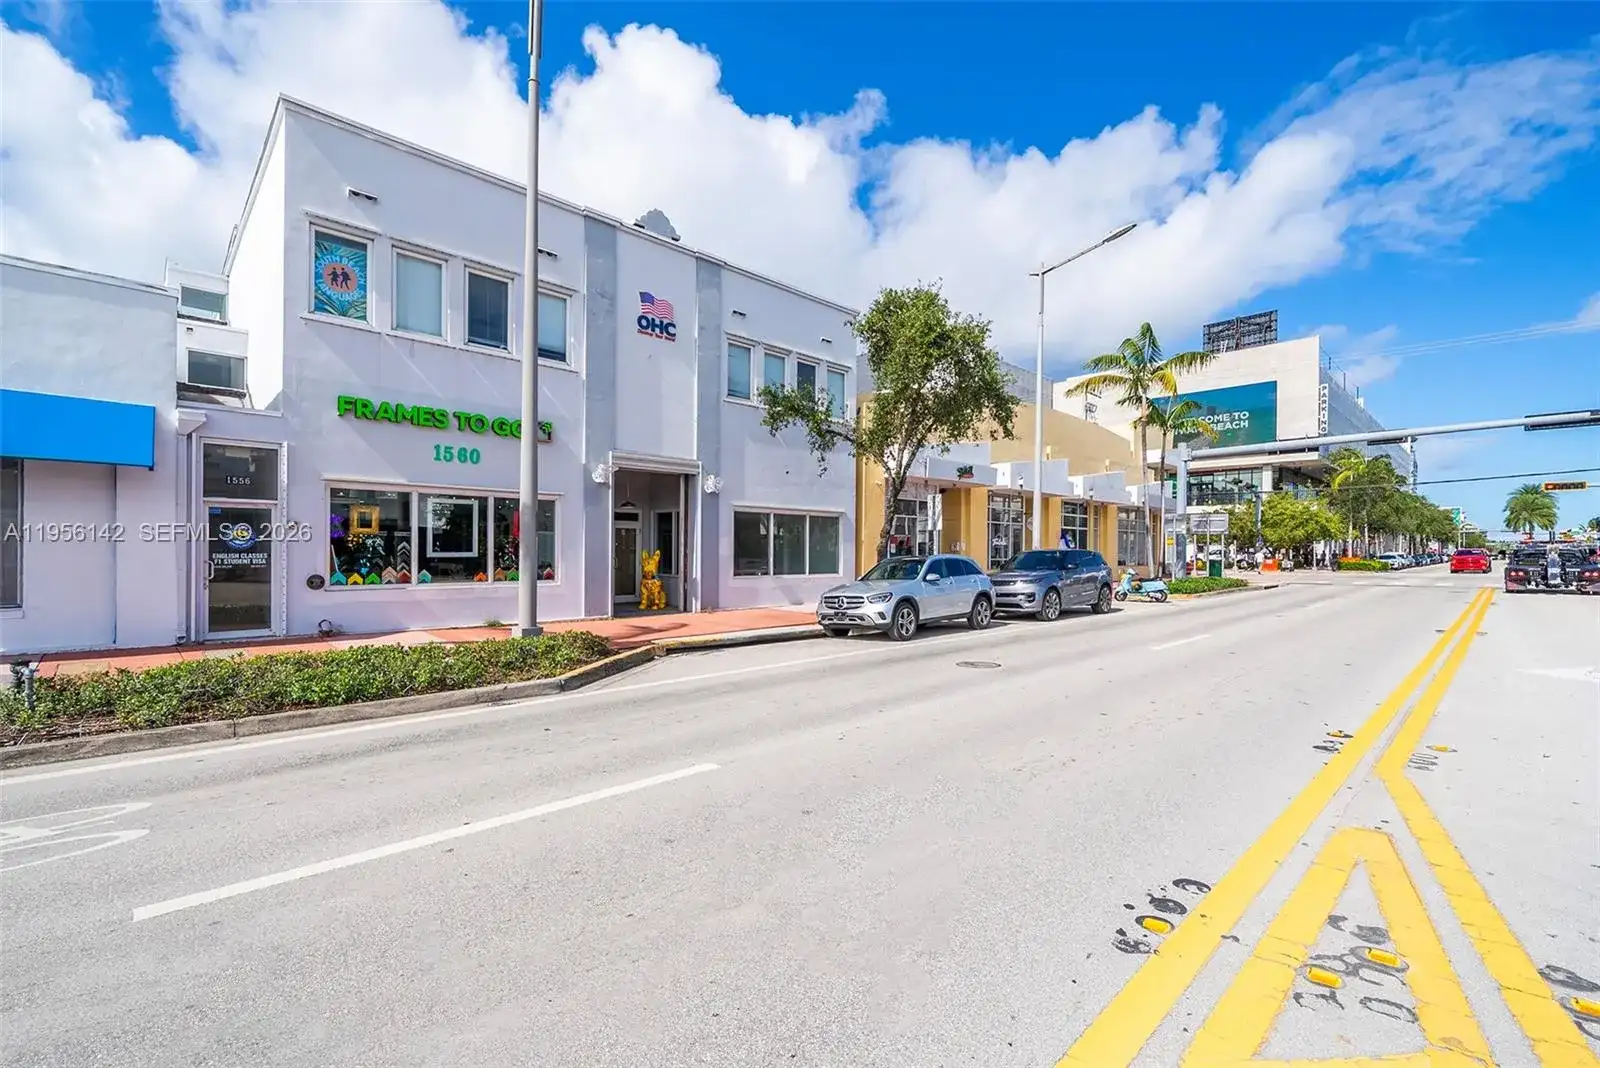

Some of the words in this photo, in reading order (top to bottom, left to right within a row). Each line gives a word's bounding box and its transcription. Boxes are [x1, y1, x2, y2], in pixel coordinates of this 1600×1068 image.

[637, 315, 676, 337] OHC
[337, 395, 450, 429] FRAMES
[453, 411, 489, 434] TO
[492, 416, 522, 439] GO
[1233, 411, 1249, 420] TO
[1320, 385, 1328, 432] PARKING
[1210, 420, 1249, 431] BEACH
[433, 444, 481, 464] 1560
[226, 476, 251, 485] 1556
